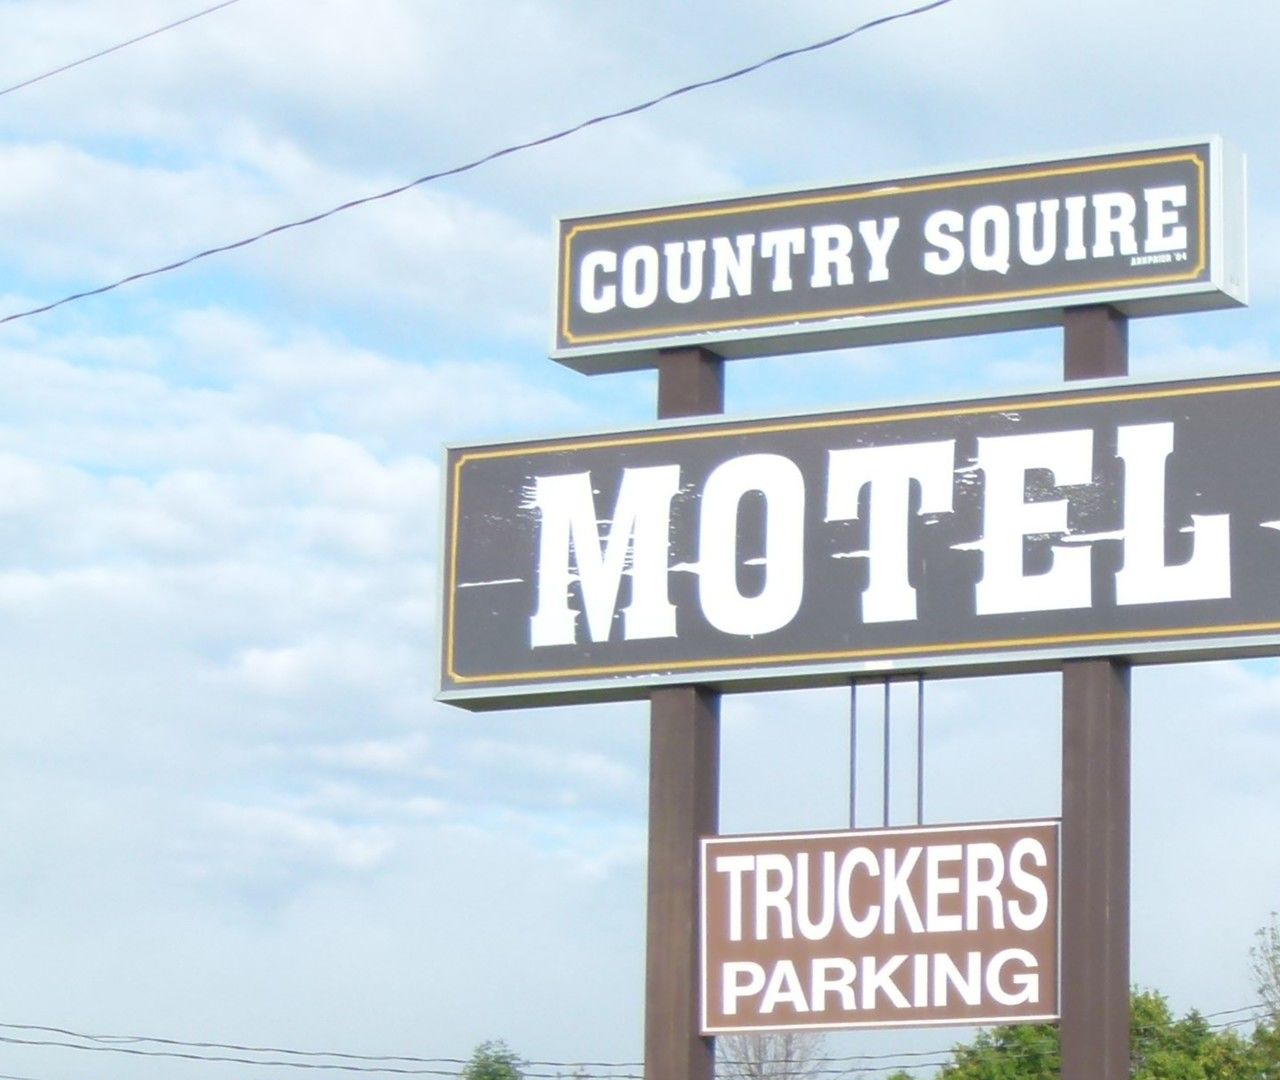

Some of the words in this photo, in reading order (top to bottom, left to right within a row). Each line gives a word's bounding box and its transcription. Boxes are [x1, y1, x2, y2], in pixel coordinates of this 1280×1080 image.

[578, 216, 900, 314] COUNTRY
[923, 184, 1188, 275] SQUIRE
[529, 421, 1232, 649] MOTEL
[716, 837, 1048, 941] TRUCKERS
[722, 948, 1039, 1015] PARKING
